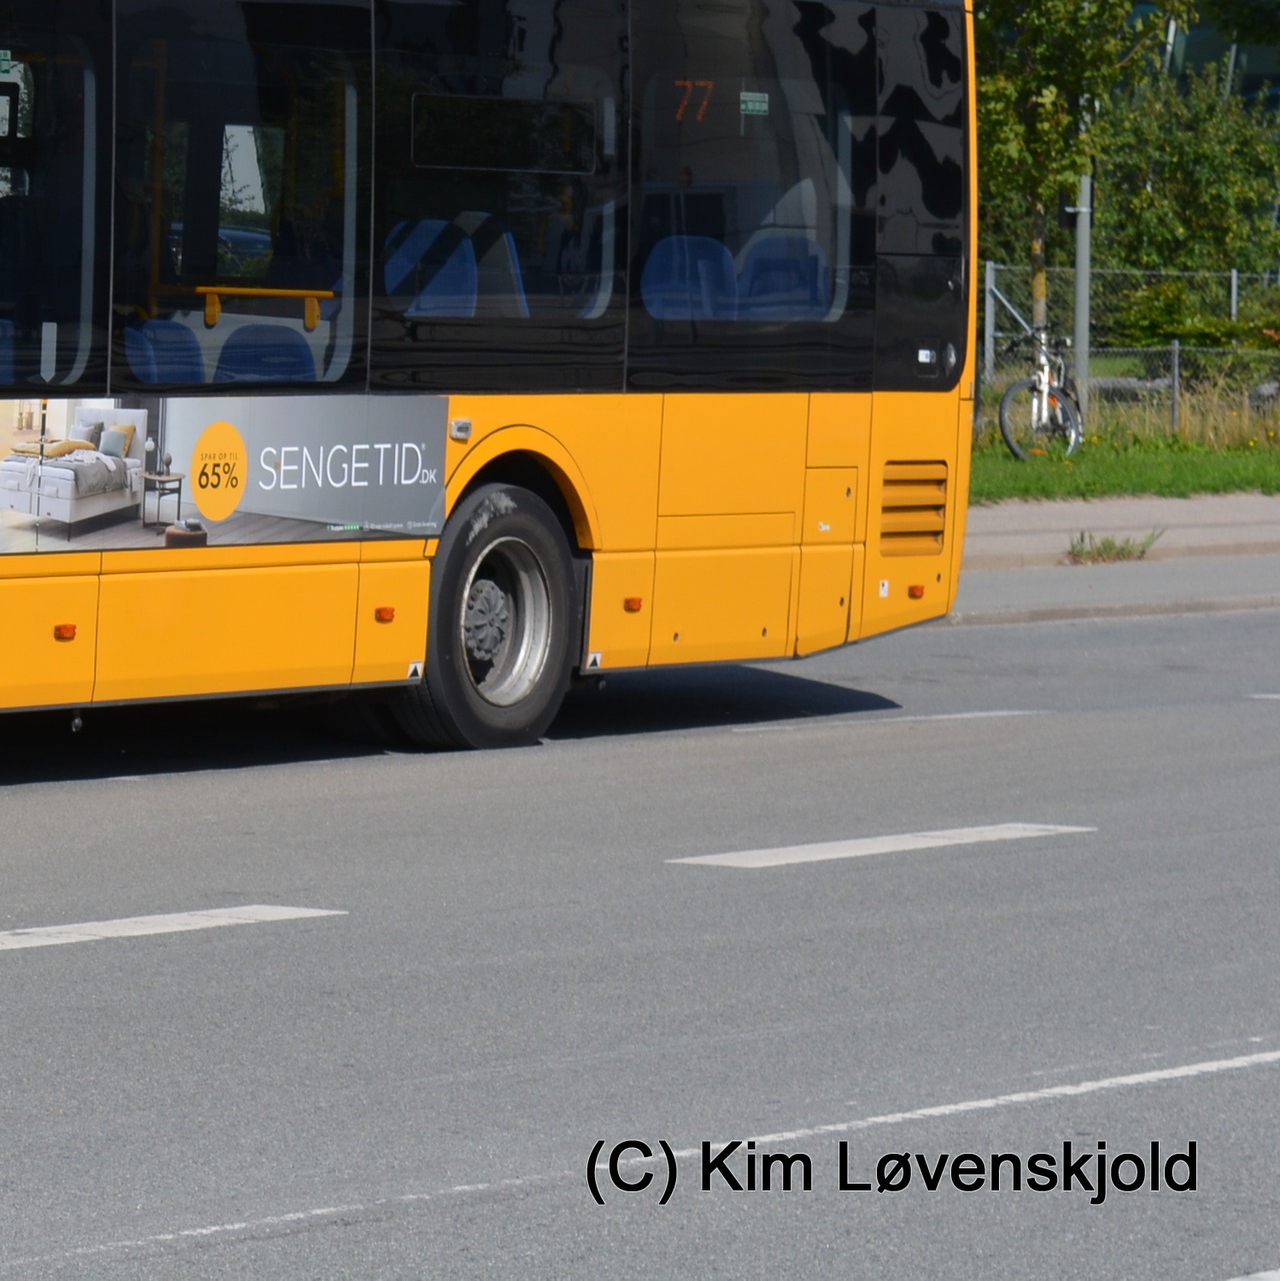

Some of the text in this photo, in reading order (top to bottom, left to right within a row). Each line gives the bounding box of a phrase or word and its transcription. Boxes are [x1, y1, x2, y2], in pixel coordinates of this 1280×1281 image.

[674, 80, 715, 121] 77
[200, 452, 238, 461] SPAR OP TIL
[198, 462, 239, 489] 65%
